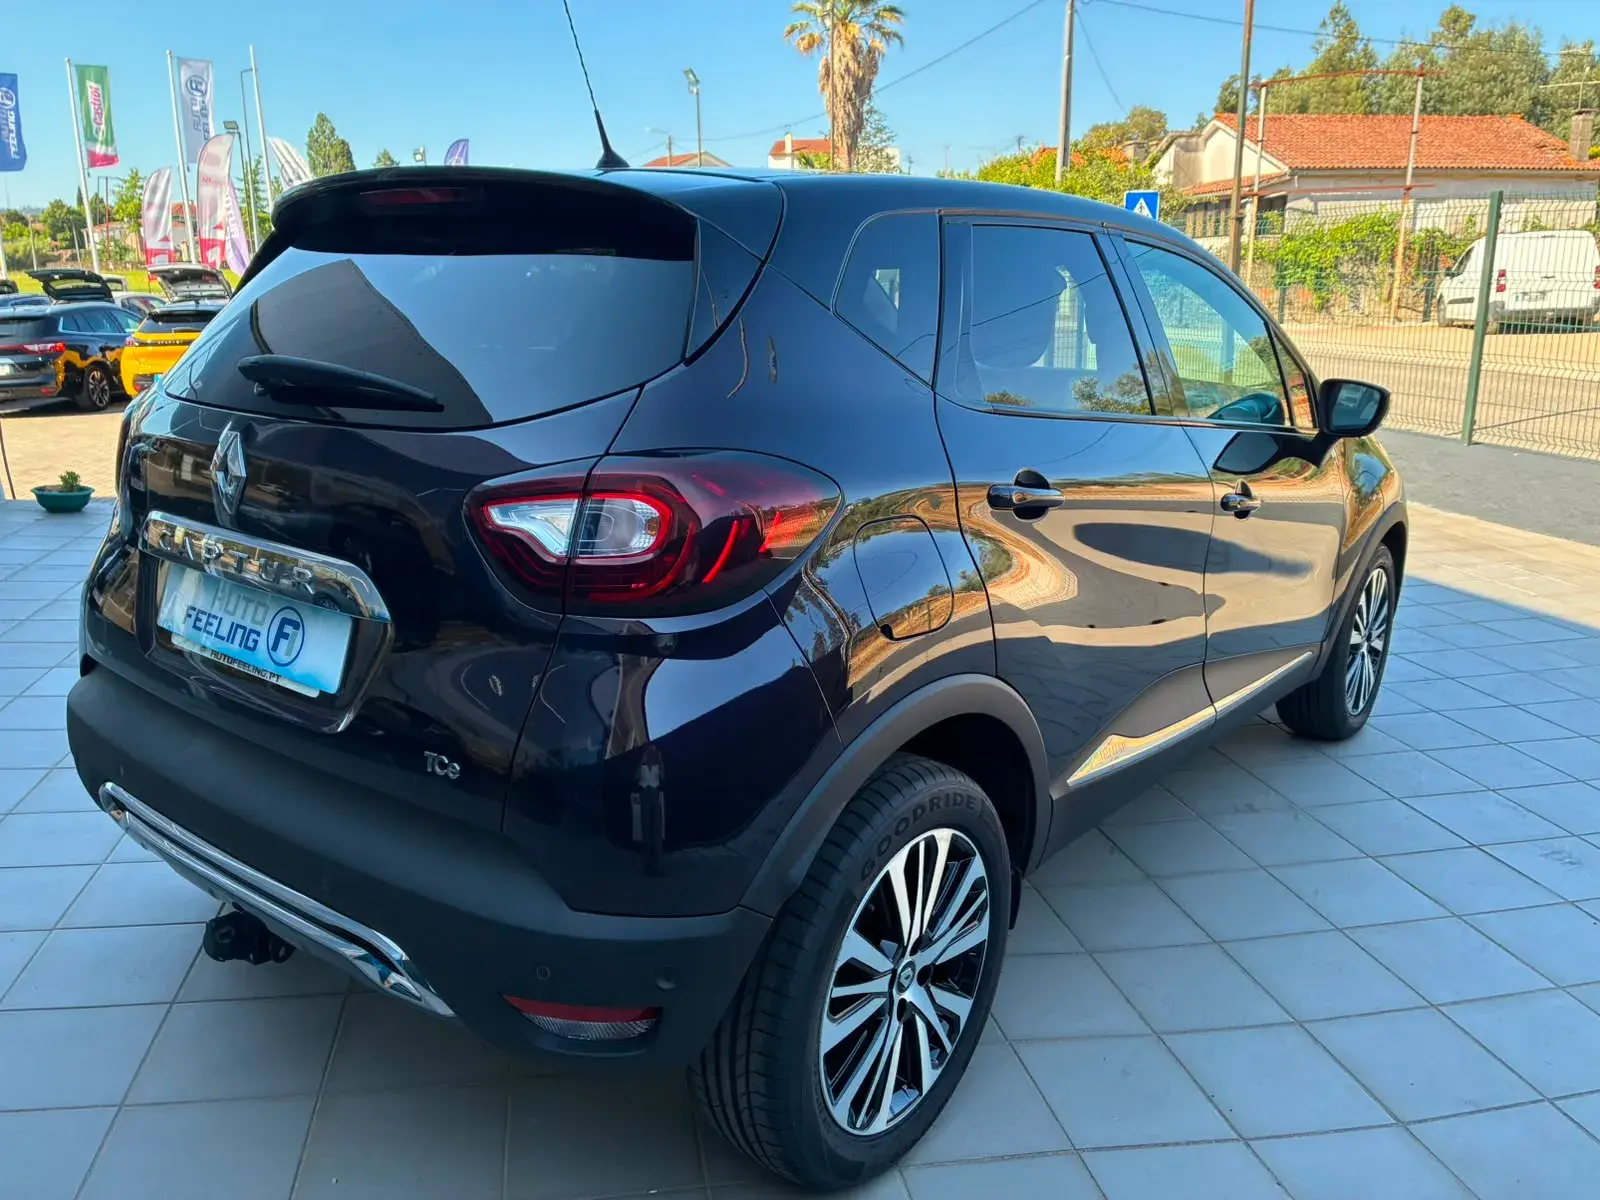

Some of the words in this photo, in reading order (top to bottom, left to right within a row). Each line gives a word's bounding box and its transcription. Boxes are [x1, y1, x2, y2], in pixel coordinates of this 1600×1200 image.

[88, 84, 104, 127] Castrol
[8, 110, 19, 159] FEELING
[158, 528, 315, 595] CAPTUR
[210, 585, 270, 626] AUTO
[183, 606, 261, 653] FEELING
[209, 648, 282, 683] AUTOFEELING.PT
[423, 750, 460, 780] TCe
[861, 792, 977, 881] GOODRIDE
